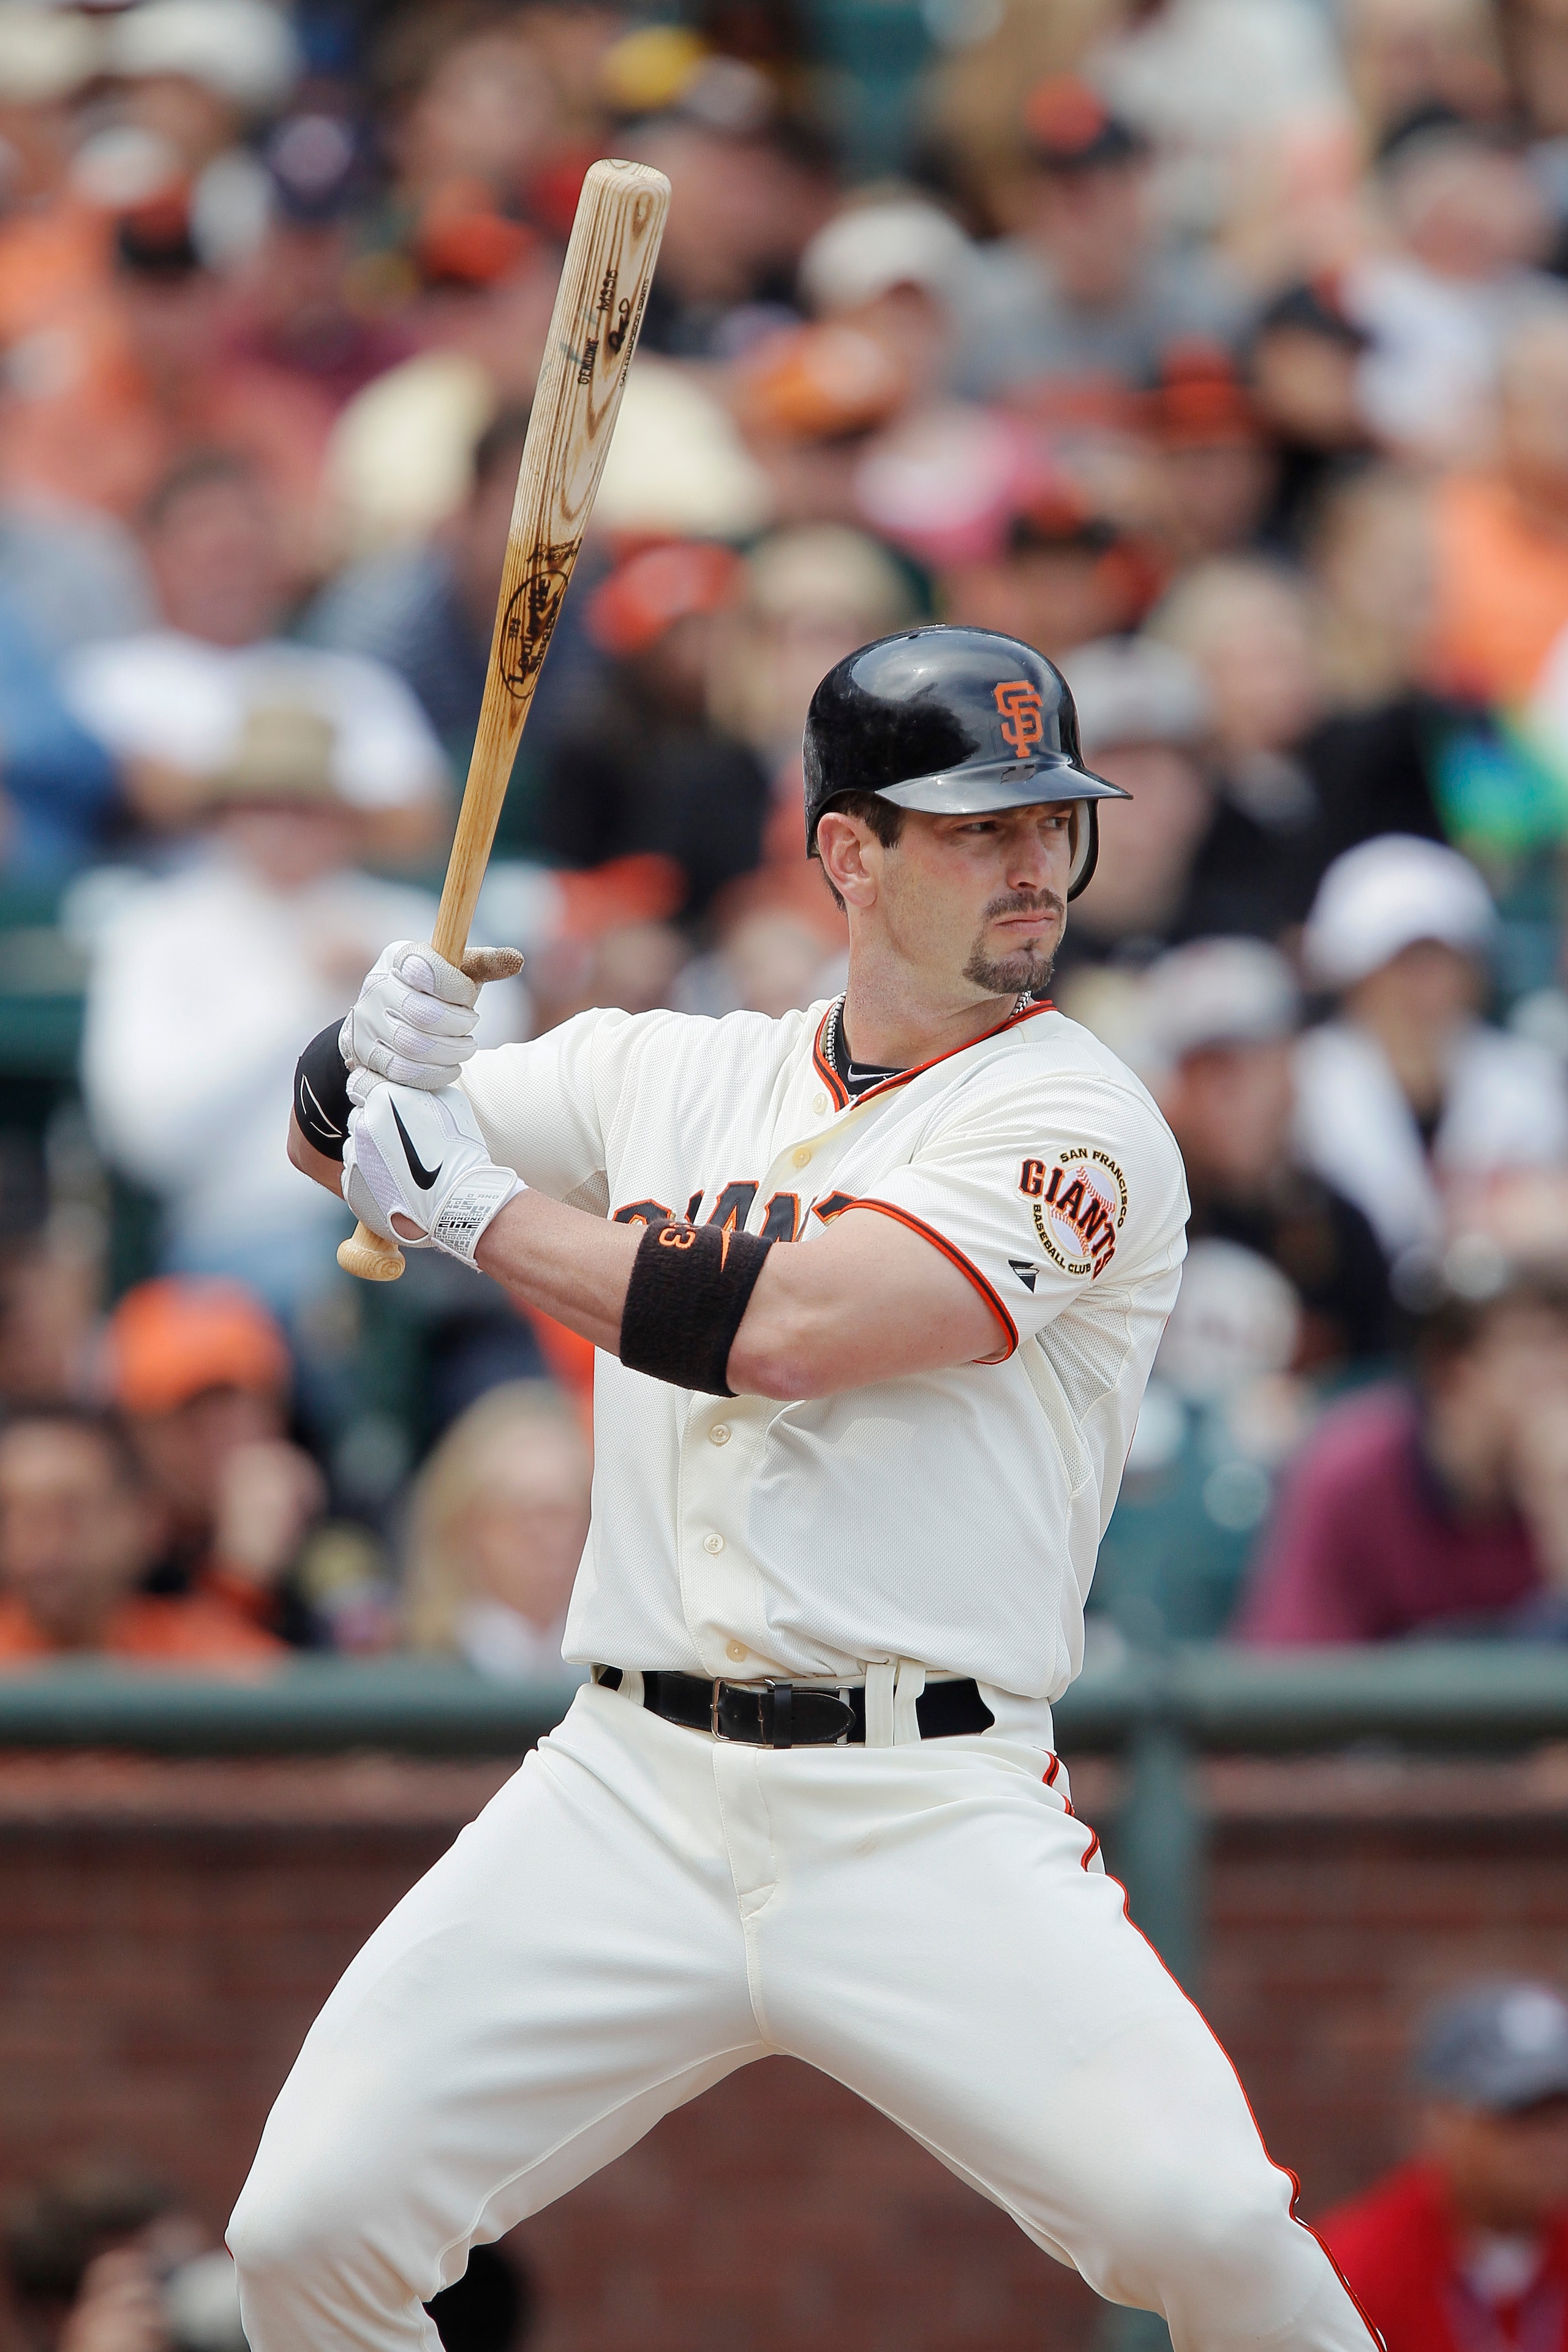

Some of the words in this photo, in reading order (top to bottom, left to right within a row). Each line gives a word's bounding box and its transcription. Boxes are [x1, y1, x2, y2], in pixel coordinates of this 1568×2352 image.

[578, 337, 599, 385] GENUINE
[993, 680, 1044, 759] SF
[1018, 1157, 1116, 1280] GIANTS
[1059, 1147, 1088, 1164] SAN
[1092, 1150, 1128, 1229] FRANCISCO
[1033, 1204, 1066, 1270] BASEBALL
[1068, 1262, 1092, 1275] CLUB
